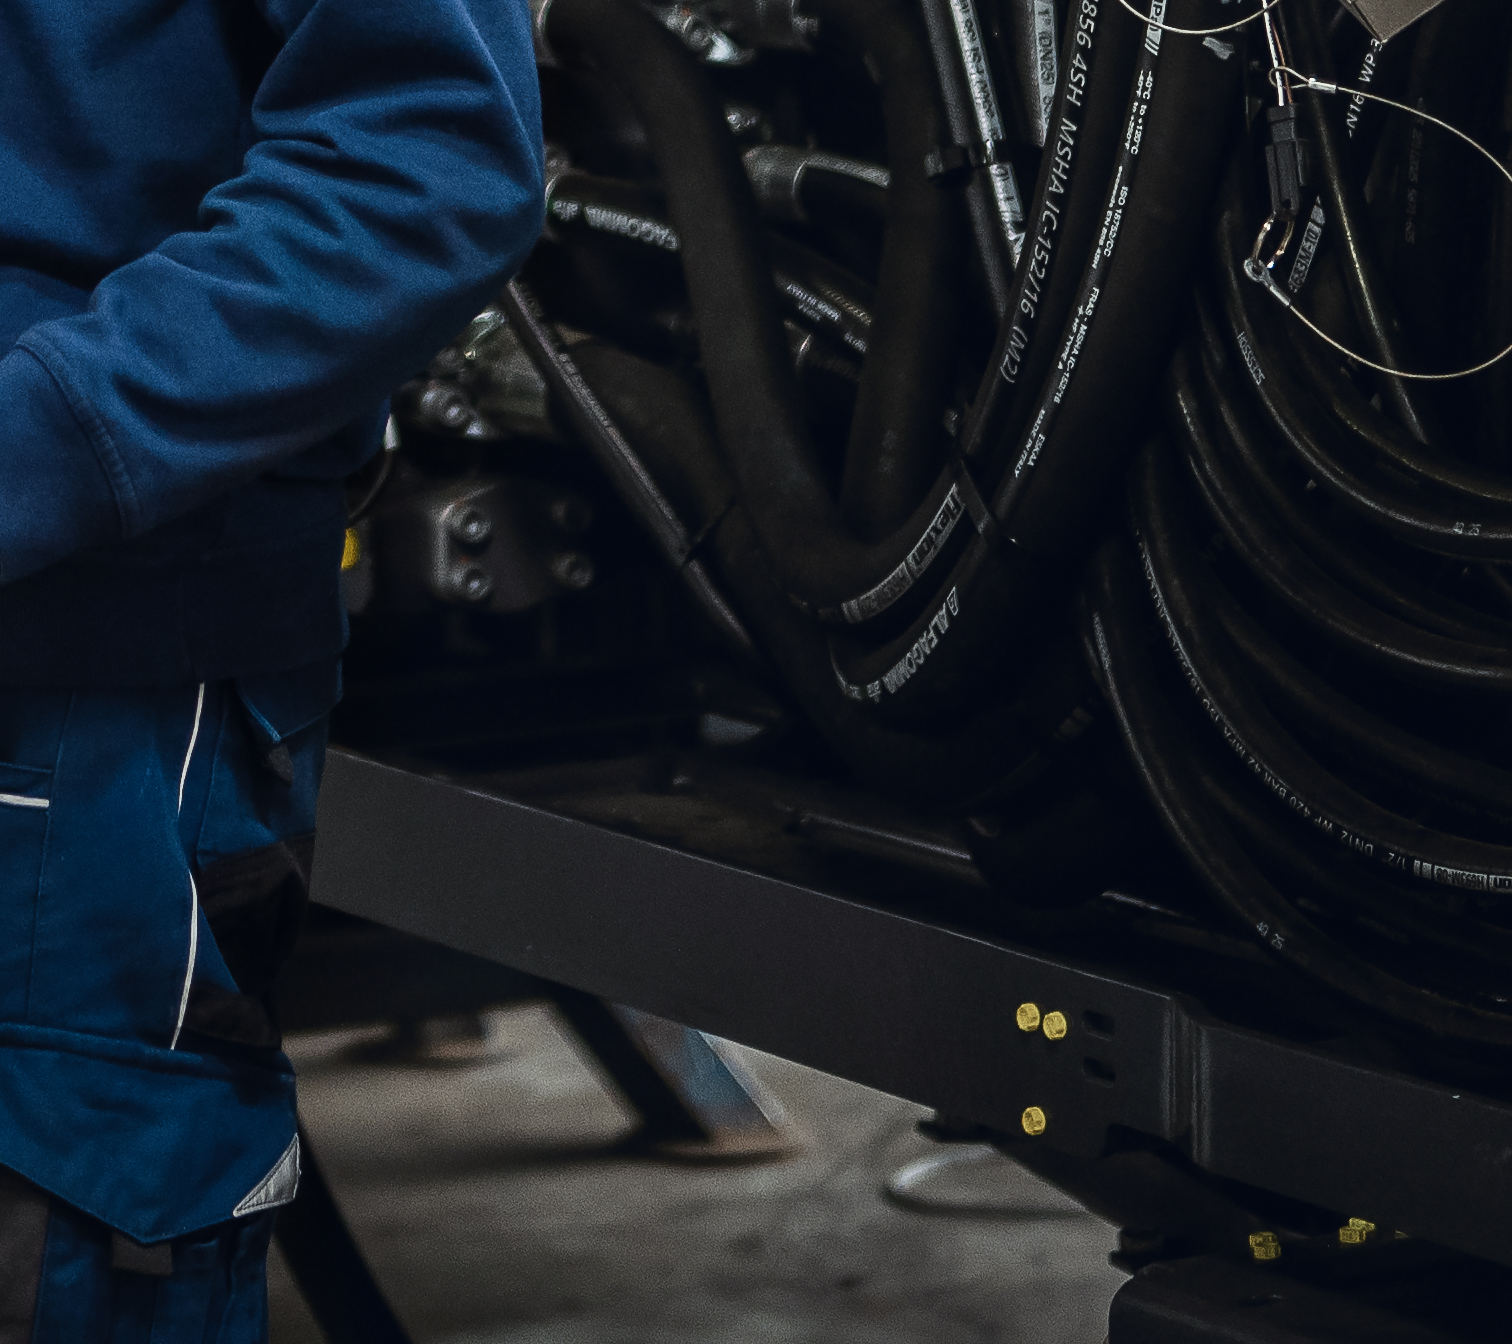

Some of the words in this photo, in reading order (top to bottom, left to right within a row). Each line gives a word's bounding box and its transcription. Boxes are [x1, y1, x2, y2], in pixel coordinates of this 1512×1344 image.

[1065, 55, 1089, 109] 4SH
[1046, 116, 1079, 196] MSHA
[1019, 208, 1061, 320] IC-152/16
[998, 324, 1029, 385] (M2)
